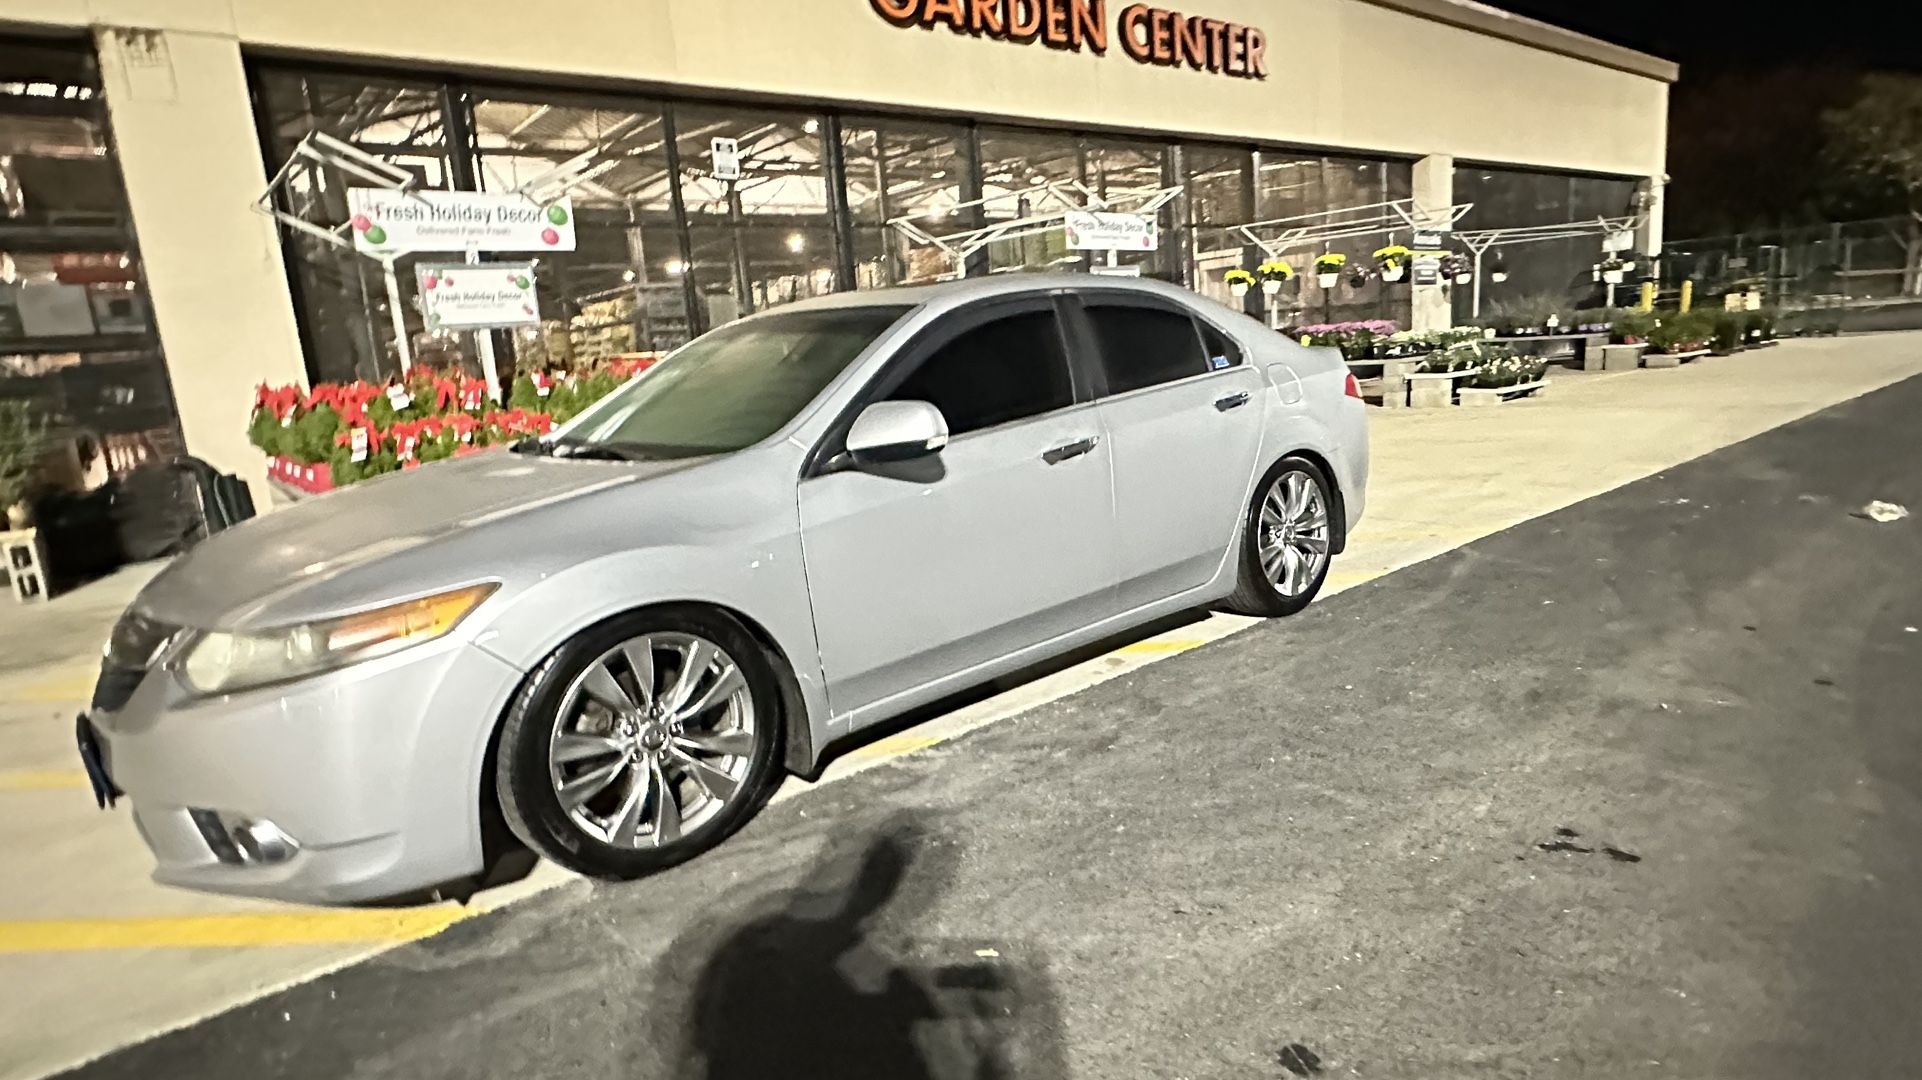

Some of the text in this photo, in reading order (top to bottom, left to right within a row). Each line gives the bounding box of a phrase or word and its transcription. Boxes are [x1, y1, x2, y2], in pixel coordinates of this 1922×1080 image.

[1120, 3, 1268, 78] CENTER
[375, 200, 542, 224] Fresh Holiday Decor
